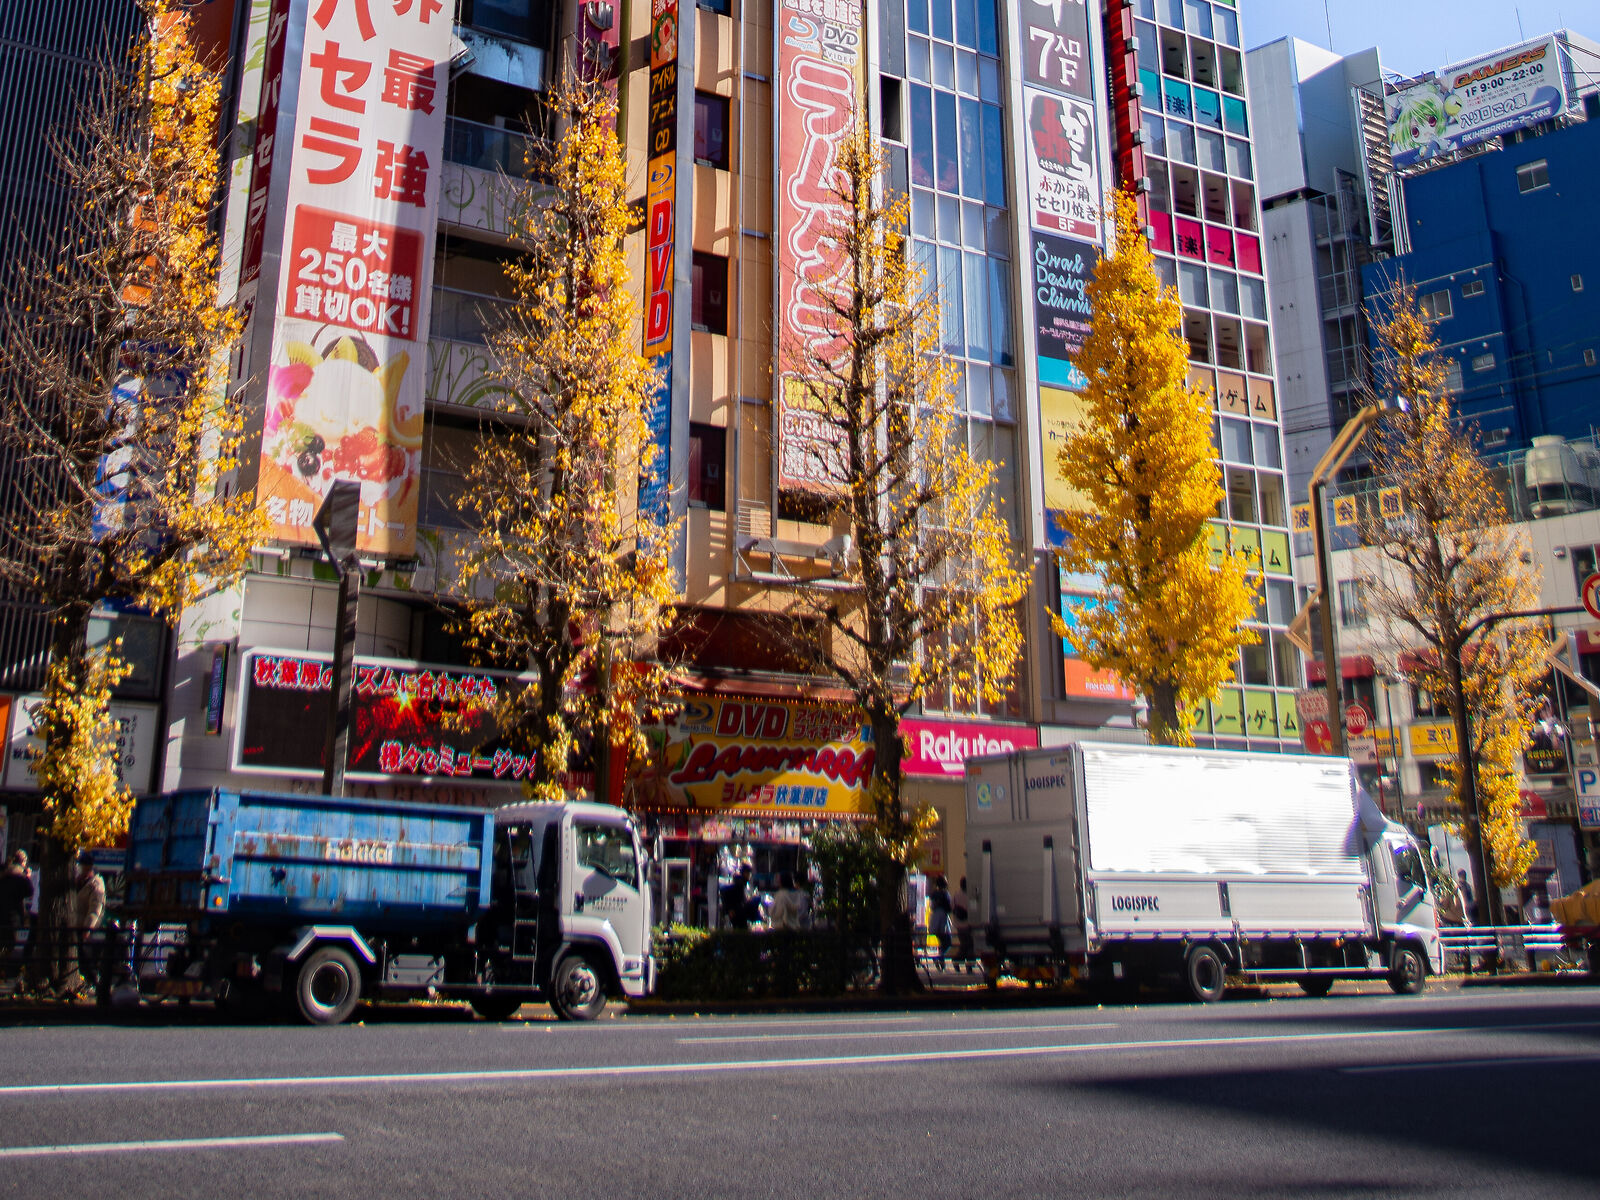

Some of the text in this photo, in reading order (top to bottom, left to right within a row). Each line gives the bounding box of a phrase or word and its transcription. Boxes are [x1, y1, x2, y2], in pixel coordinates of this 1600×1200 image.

[824, 25, 859, 46] DVD
[1055, 33, 1081, 59] 入口
[651, 64, 676, 96] アイドル
[1453, 43, 1550, 90] GAMERS
[651, 93, 675, 123] アニメ
[1465, 86, 1477, 98] 1F
[655, 128, 670, 151] CD
[1039, 175, 1090, 203] 赤から鍋
[331, 221, 388, 261] 最大
[298, 247, 413, 301] 250名様
[647, 198, 673, 347] DVD
[293, 284, 411, 336] 貸切OK!
[264, 497, 406, 540] 名物 ニトー
[254, 655, 498, 702] 秋葉原のズムに合わせた
[715, 702, 789, 739] DVD
[379, 740, 537, 780] 様々なミュージッ
[920, 729, 1014, 761] Rakuten
[775, 785, 829, 807] 秋葉原店
[1025, 775, 1066, 791] LOGISPEC
[1578, 769, 1597, 794] P
[1111, 894, 1161, 912] LOGISPEC
